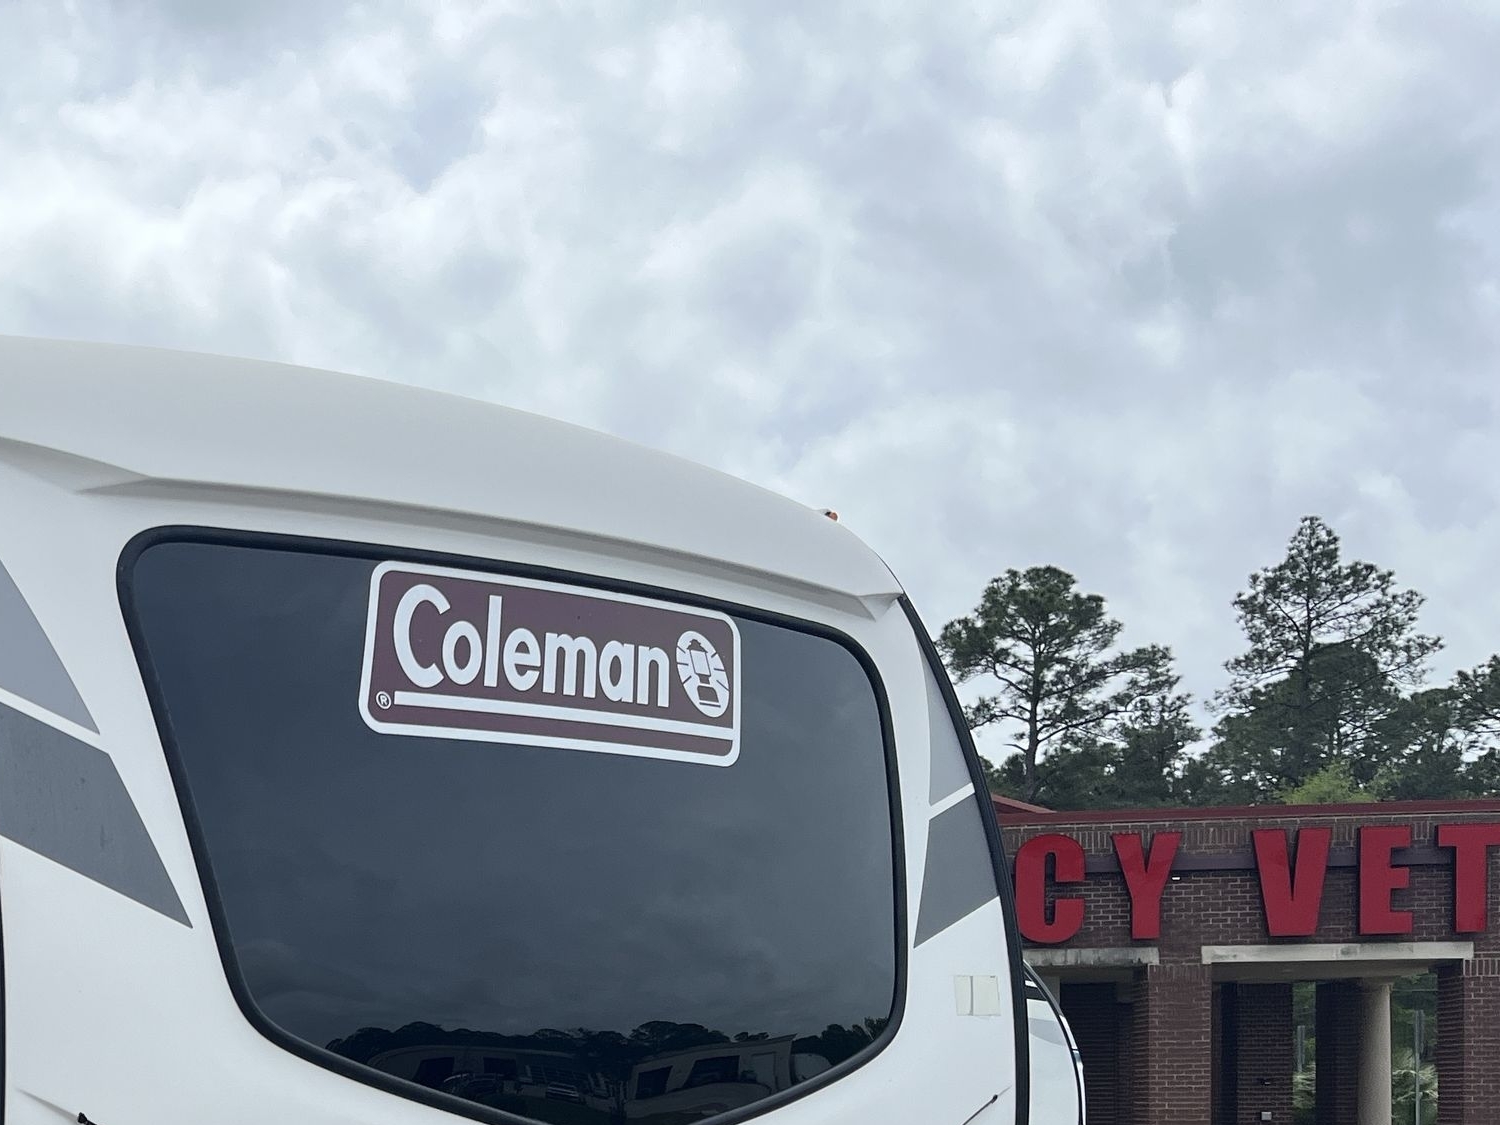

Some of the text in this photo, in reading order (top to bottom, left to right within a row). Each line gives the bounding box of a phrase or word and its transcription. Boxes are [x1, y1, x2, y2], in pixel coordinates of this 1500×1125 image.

[393, 583, 670, 708] Coleman
[1014, 823, 1500, 944] CY VET
